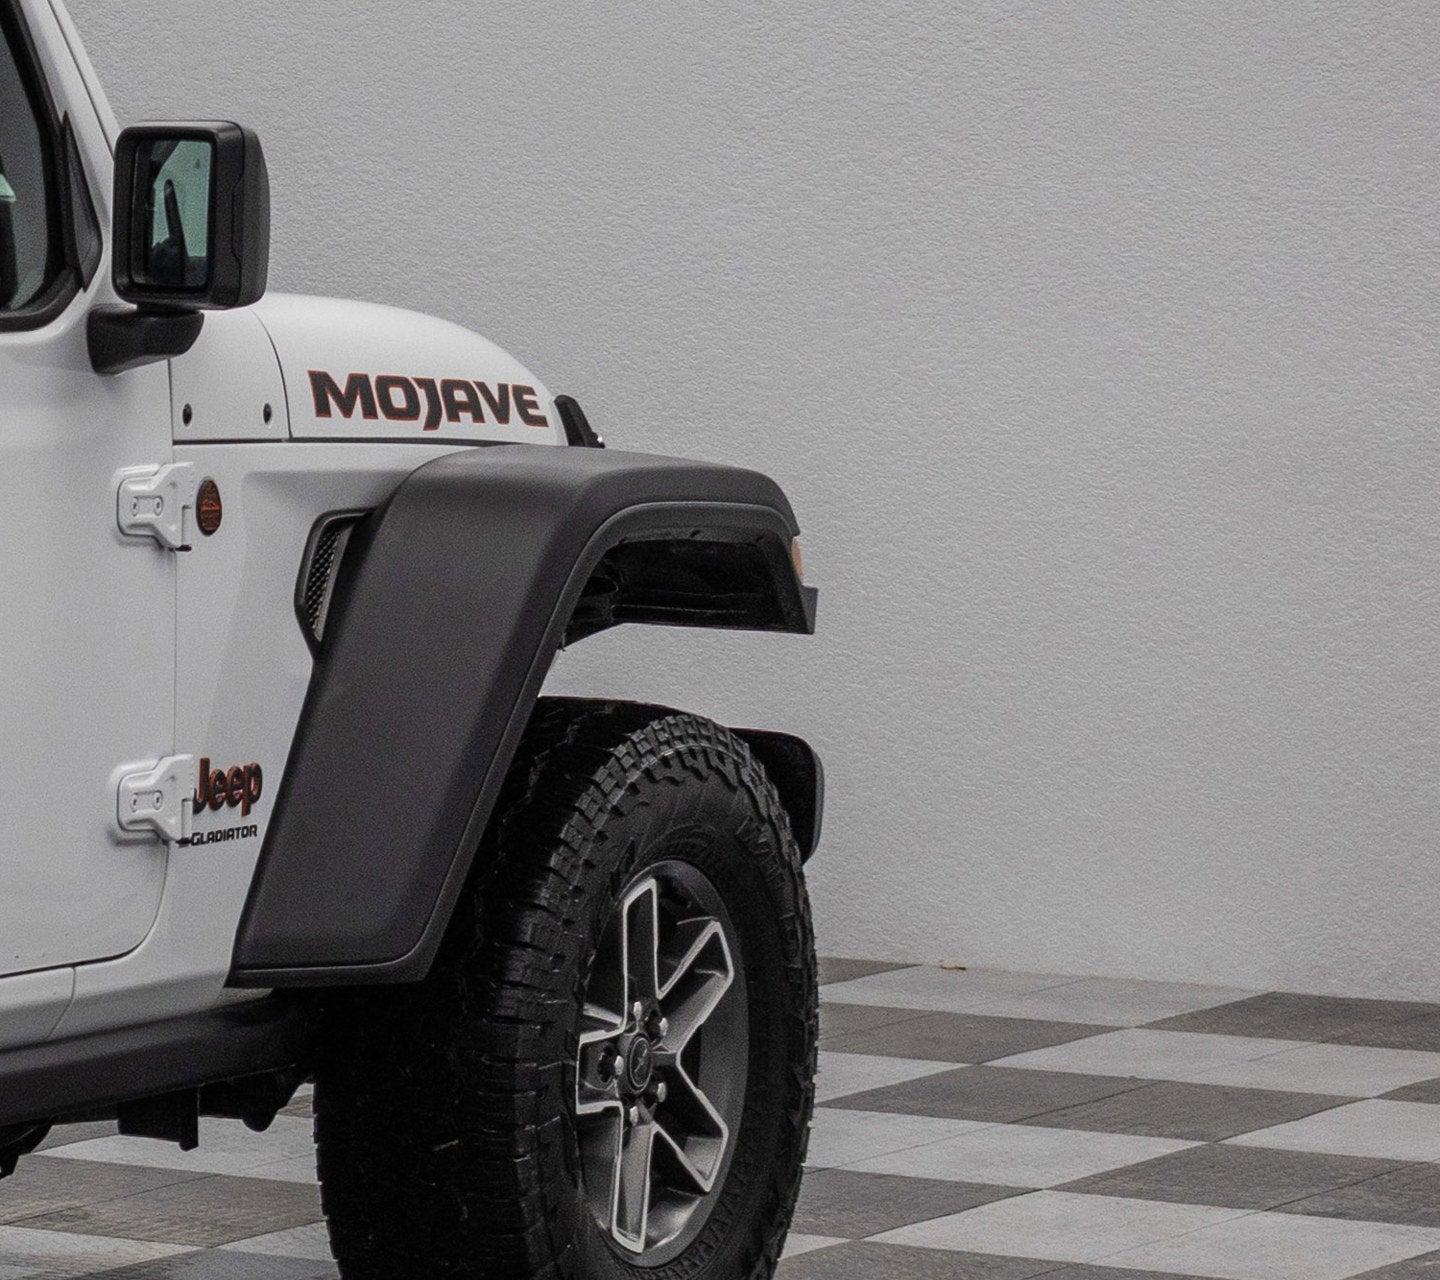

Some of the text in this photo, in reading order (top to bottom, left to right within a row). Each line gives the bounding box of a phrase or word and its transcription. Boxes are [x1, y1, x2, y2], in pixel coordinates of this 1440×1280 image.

[307, 370, 549, 431] MOJAVE
[193, 757, 263, 817] Jeep
[190, 824, 258, 847] GLADIATOR
